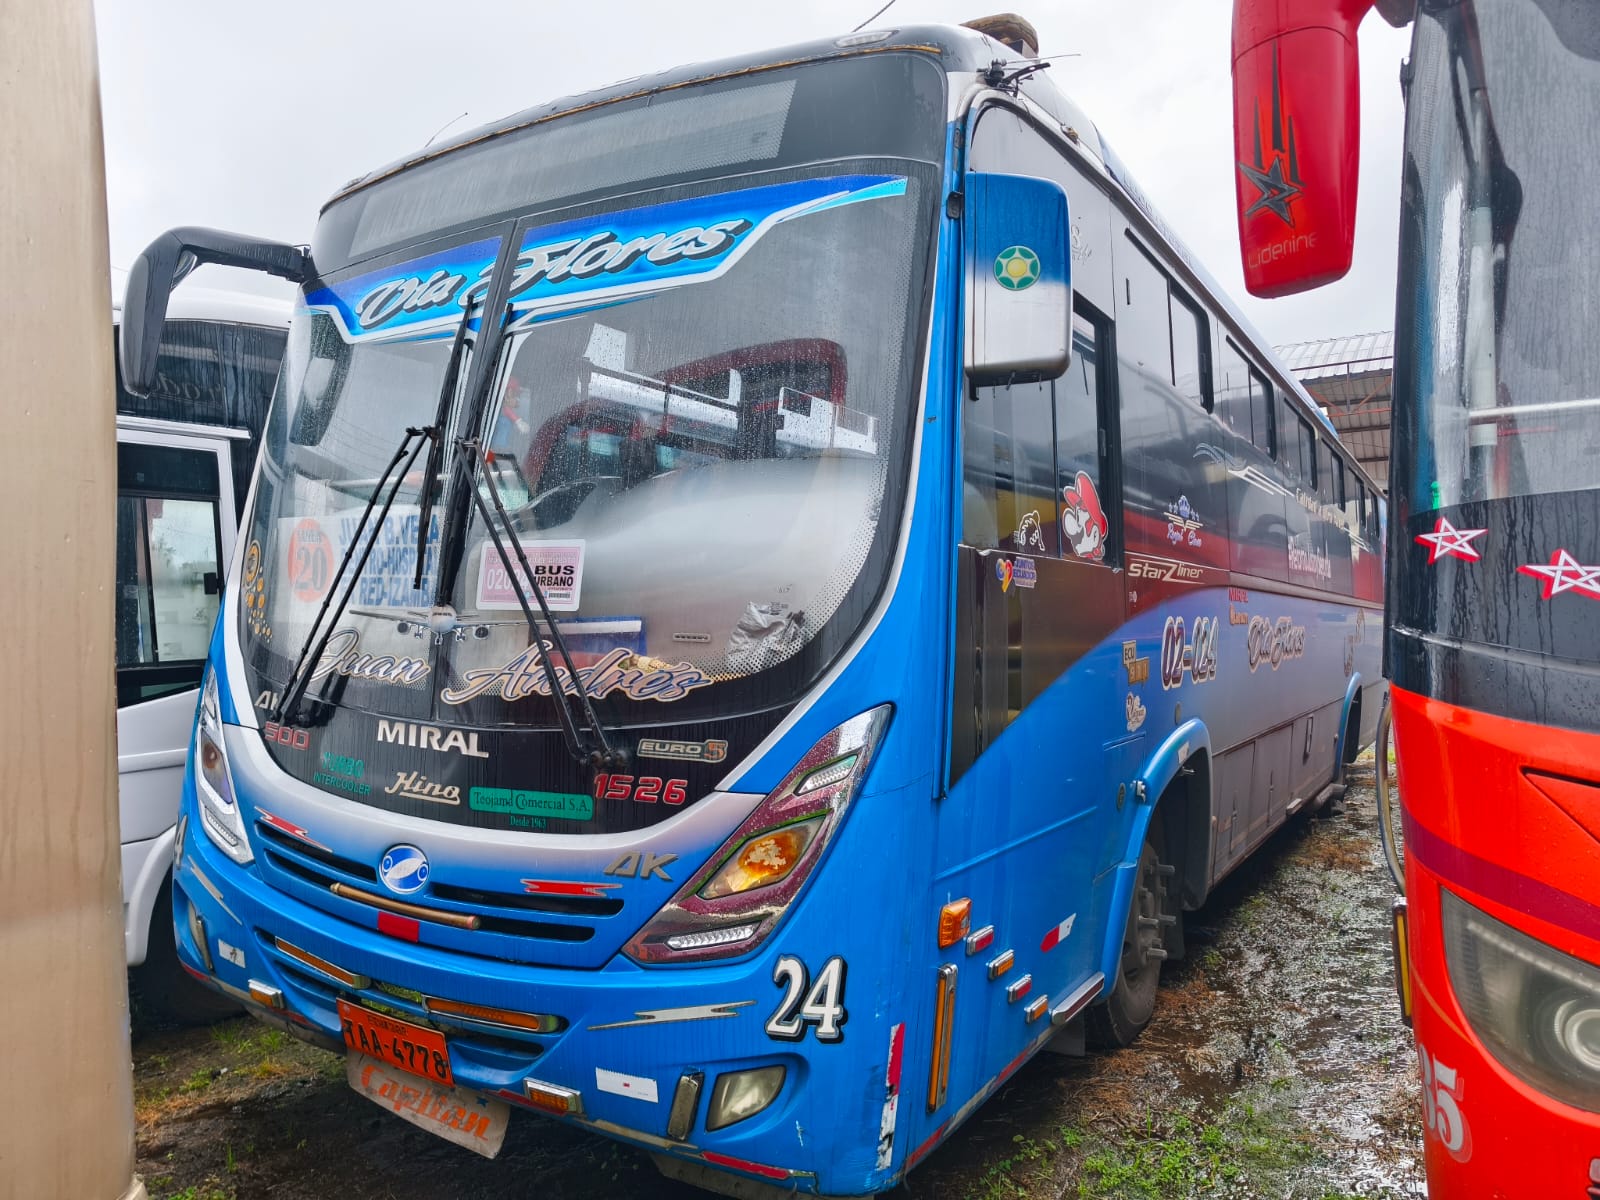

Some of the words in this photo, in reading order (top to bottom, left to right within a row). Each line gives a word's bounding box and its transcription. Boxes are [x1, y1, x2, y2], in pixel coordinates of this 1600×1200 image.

[296, 547, 328, 591] 20
[534, 565, 575, 576] BUS
[534, 576, 574, 587] URBANO
[300, 627, 432, 683] Juan
[1162, 616, 1219, 691] 02-024
[264, 720, 310, 751] 500
[377, 719, 490, 758] MIRAL
[641, 740, 702, 755] EURO
[704, 741, 727, 761] 5
[313, 771, 372, 796] INTERCOOLER
[384, 770, 461, 807] Hino
[594, 773, 689, 805] 1526
[515, 793, 566, 811] Comercial
[568, 799, 591, 812] S.A.
[509, 815, 532, 827] Desde
[603, 850, 678, 882] AK
[764, 953, 848, 1043] 24
